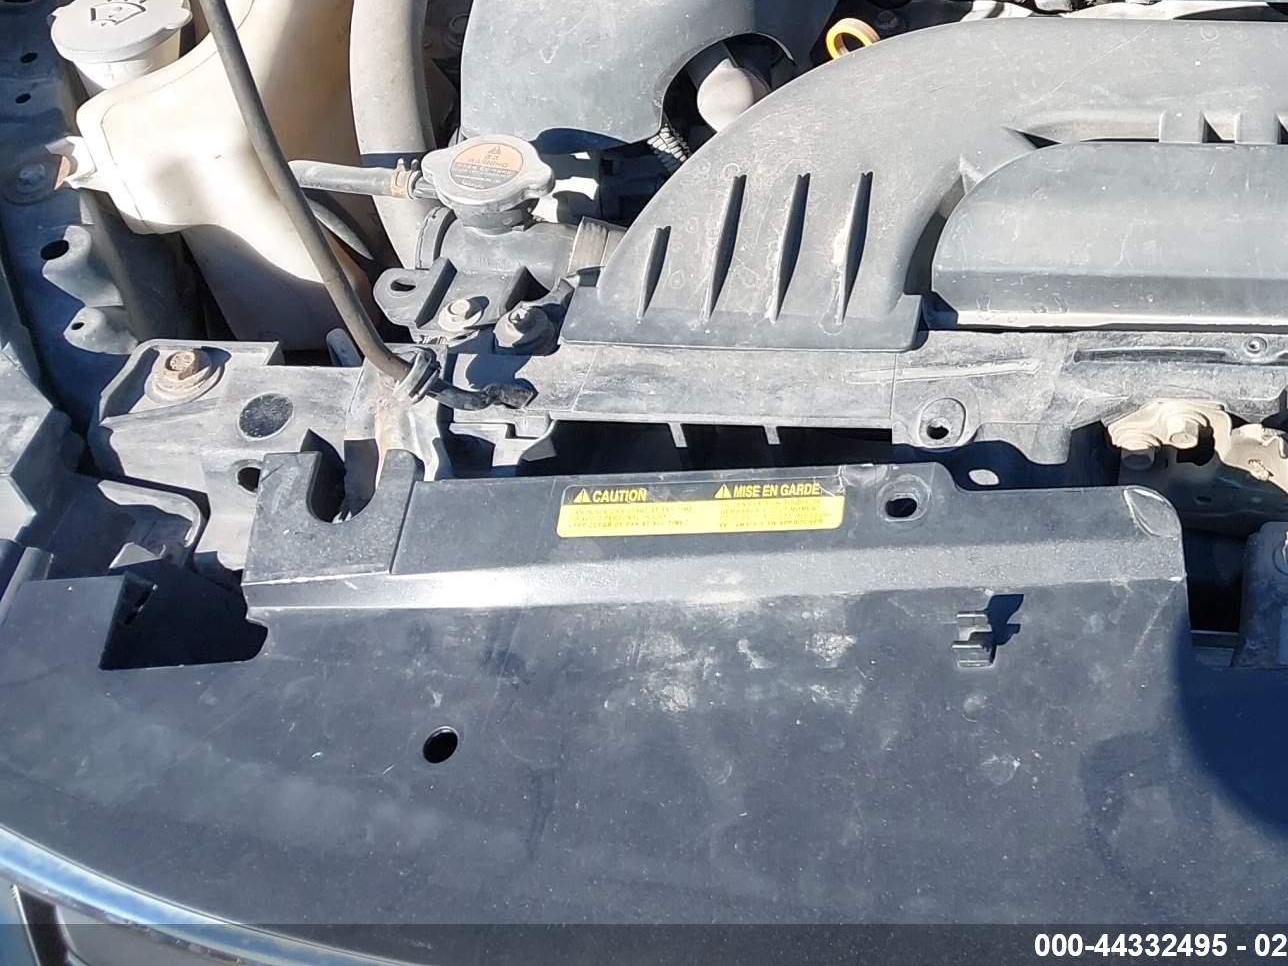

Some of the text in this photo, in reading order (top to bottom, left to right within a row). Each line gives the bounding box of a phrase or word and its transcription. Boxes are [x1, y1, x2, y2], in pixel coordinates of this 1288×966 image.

[592, 488, 647, 503] CAUTION
[733, 483, 820, 498] MISE EN GARDE
